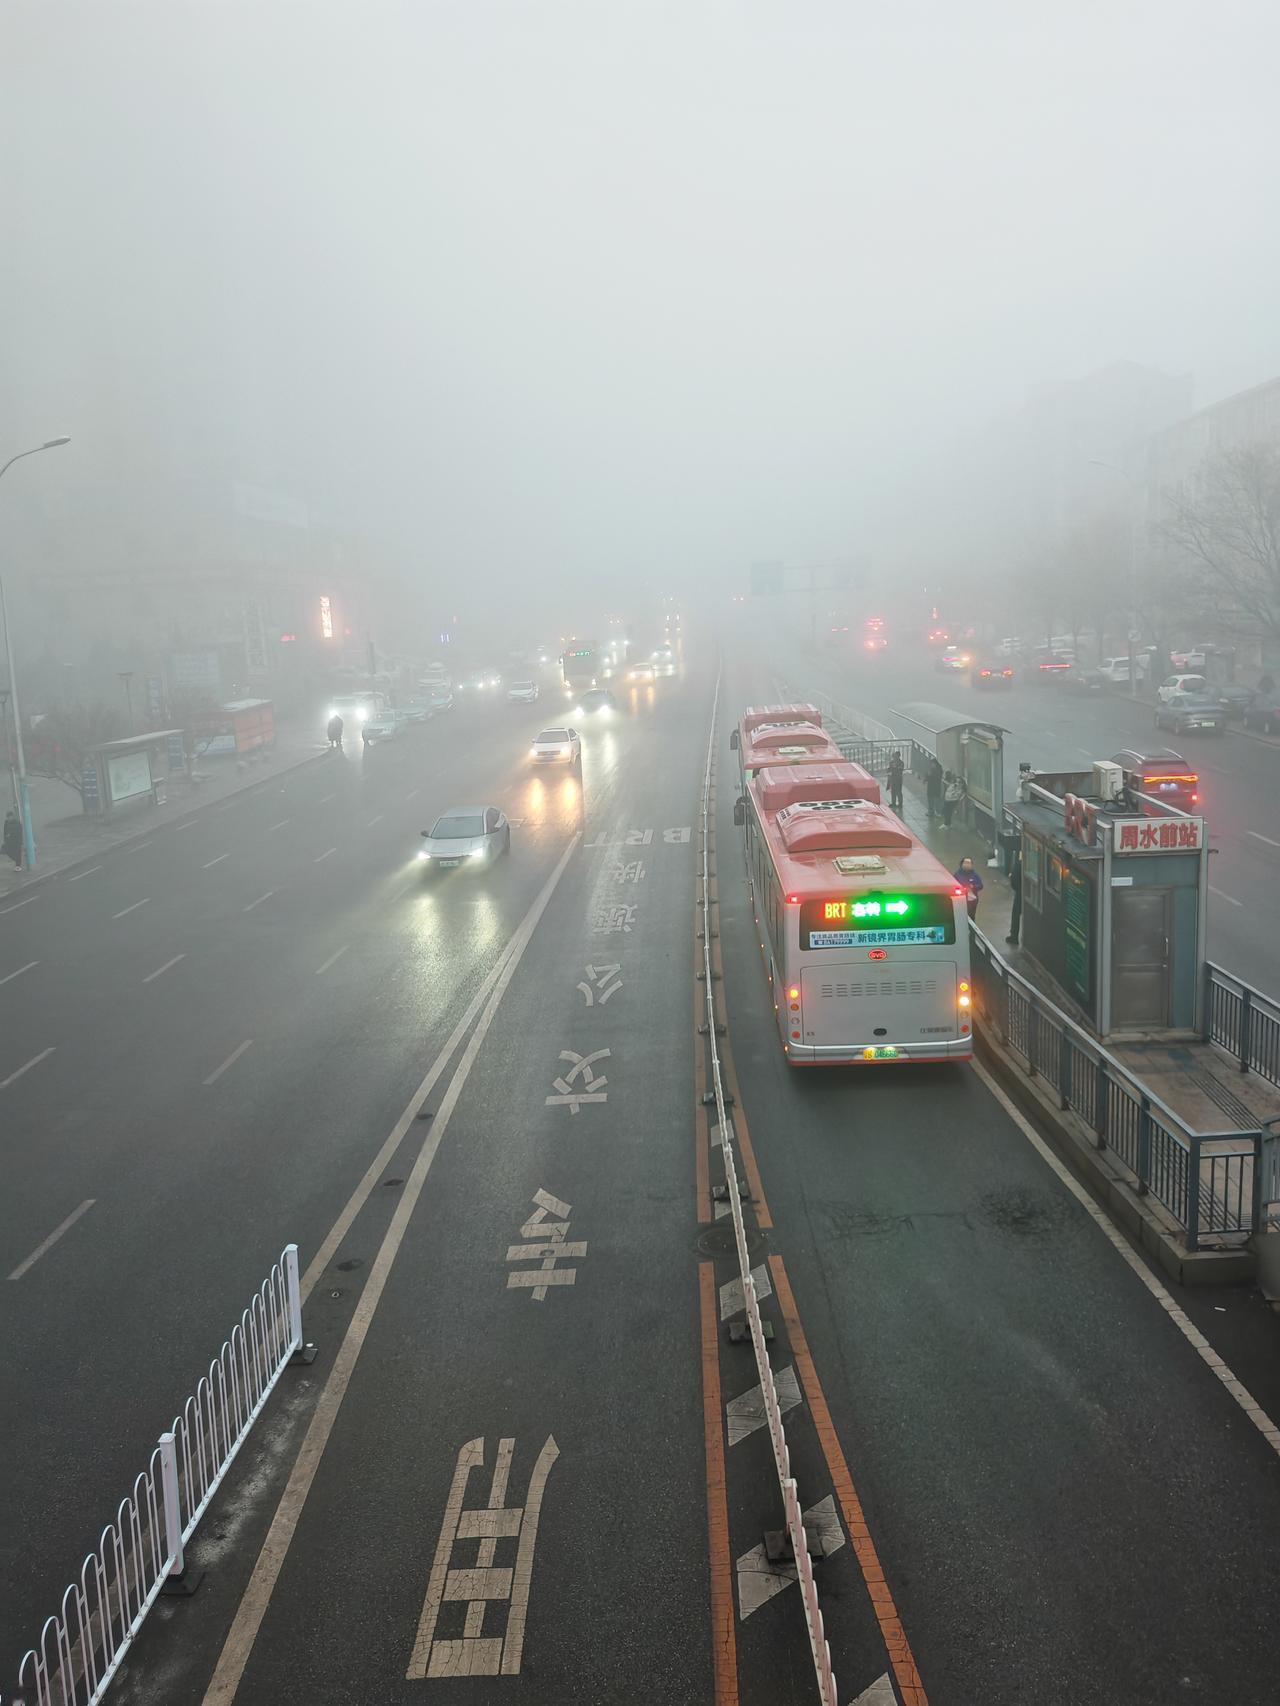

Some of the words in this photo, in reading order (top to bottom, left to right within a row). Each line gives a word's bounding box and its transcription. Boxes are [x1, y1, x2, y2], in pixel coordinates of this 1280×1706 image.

[1119, 822, 1198, 850] 周水前站
[825, 903, 847, 918] BRT
